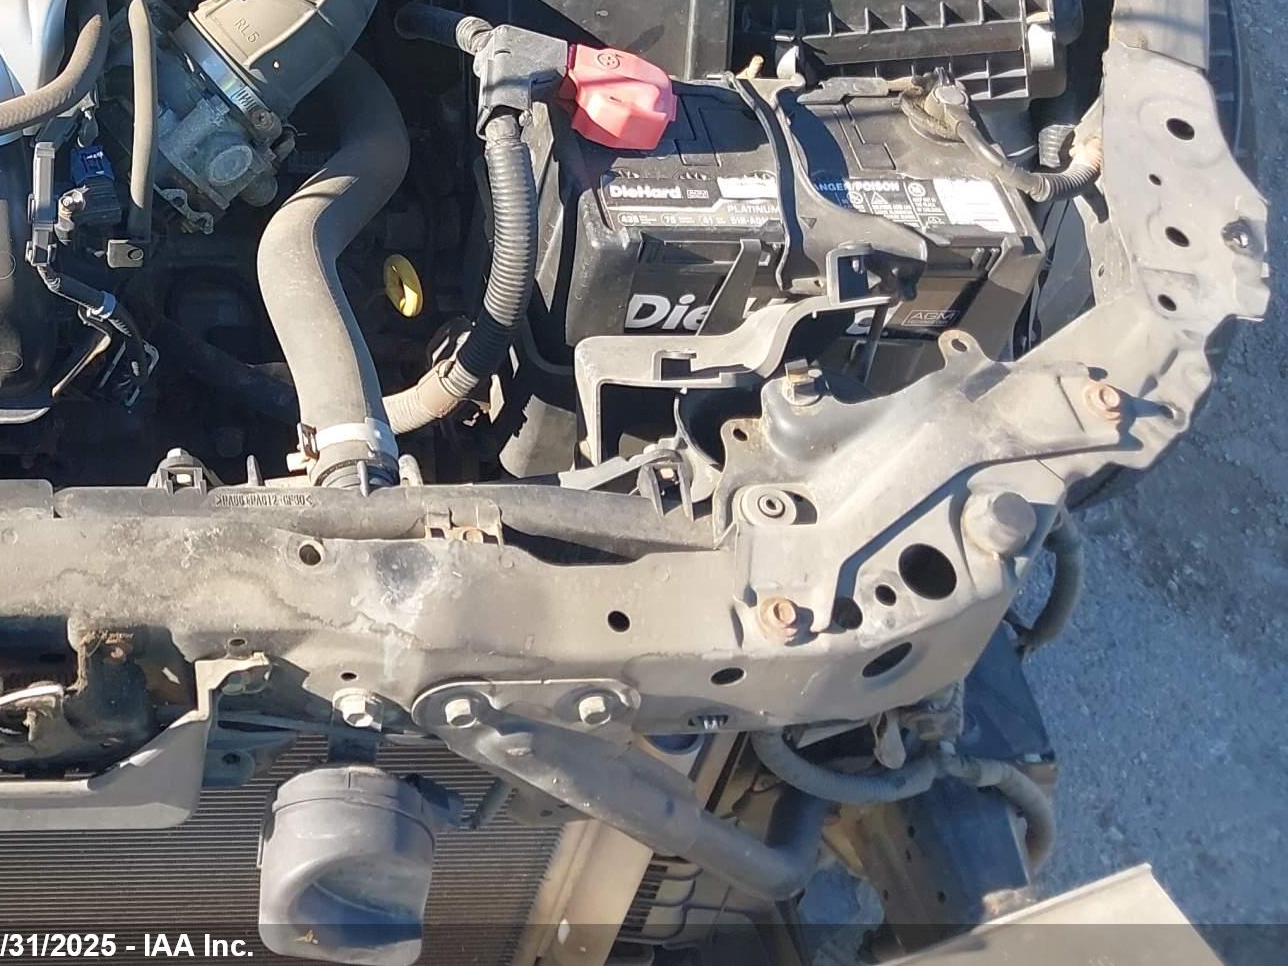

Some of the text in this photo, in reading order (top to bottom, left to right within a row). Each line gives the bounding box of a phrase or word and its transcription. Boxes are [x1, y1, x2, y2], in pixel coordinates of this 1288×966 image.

[609, 186, 682, 199] DieHard
[727, 205, 779, 214] PLATINUM
[910, 312, 955, 322] AGM
